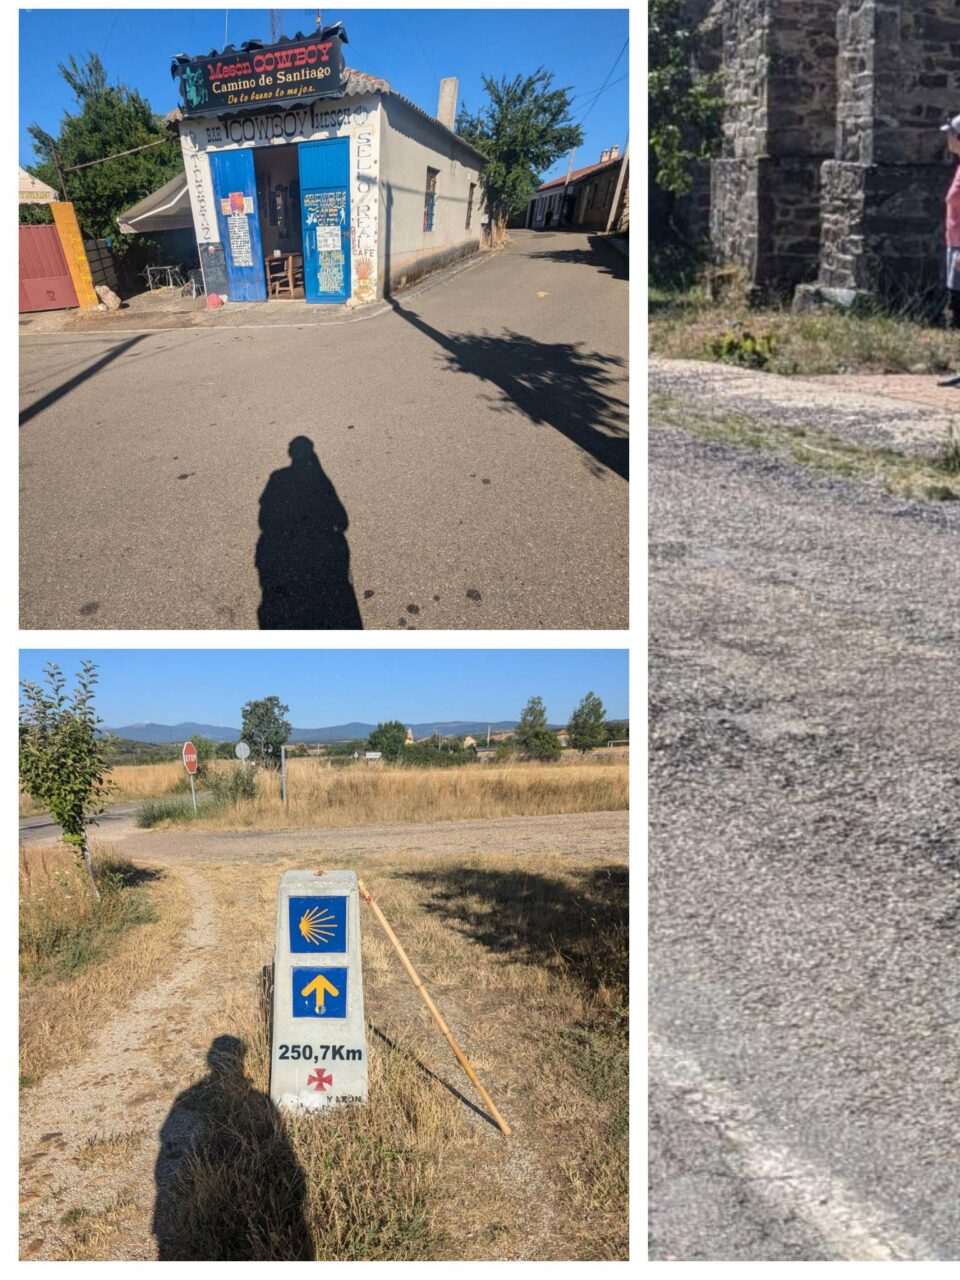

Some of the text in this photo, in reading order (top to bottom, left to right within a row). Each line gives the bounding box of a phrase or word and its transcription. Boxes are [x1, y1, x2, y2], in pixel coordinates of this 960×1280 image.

[254, 42, 333, 73] COWBOY
[212, 66, 331, 94] Camino de Santiago
[227, 94, 238, 105] De
[250, 90, 273, 101] bueno
[205, 127, 223, 143] BAR
[230, 109, 308, 143] COWBOY
[278, 1044, 363, 1064] 250,7Km
